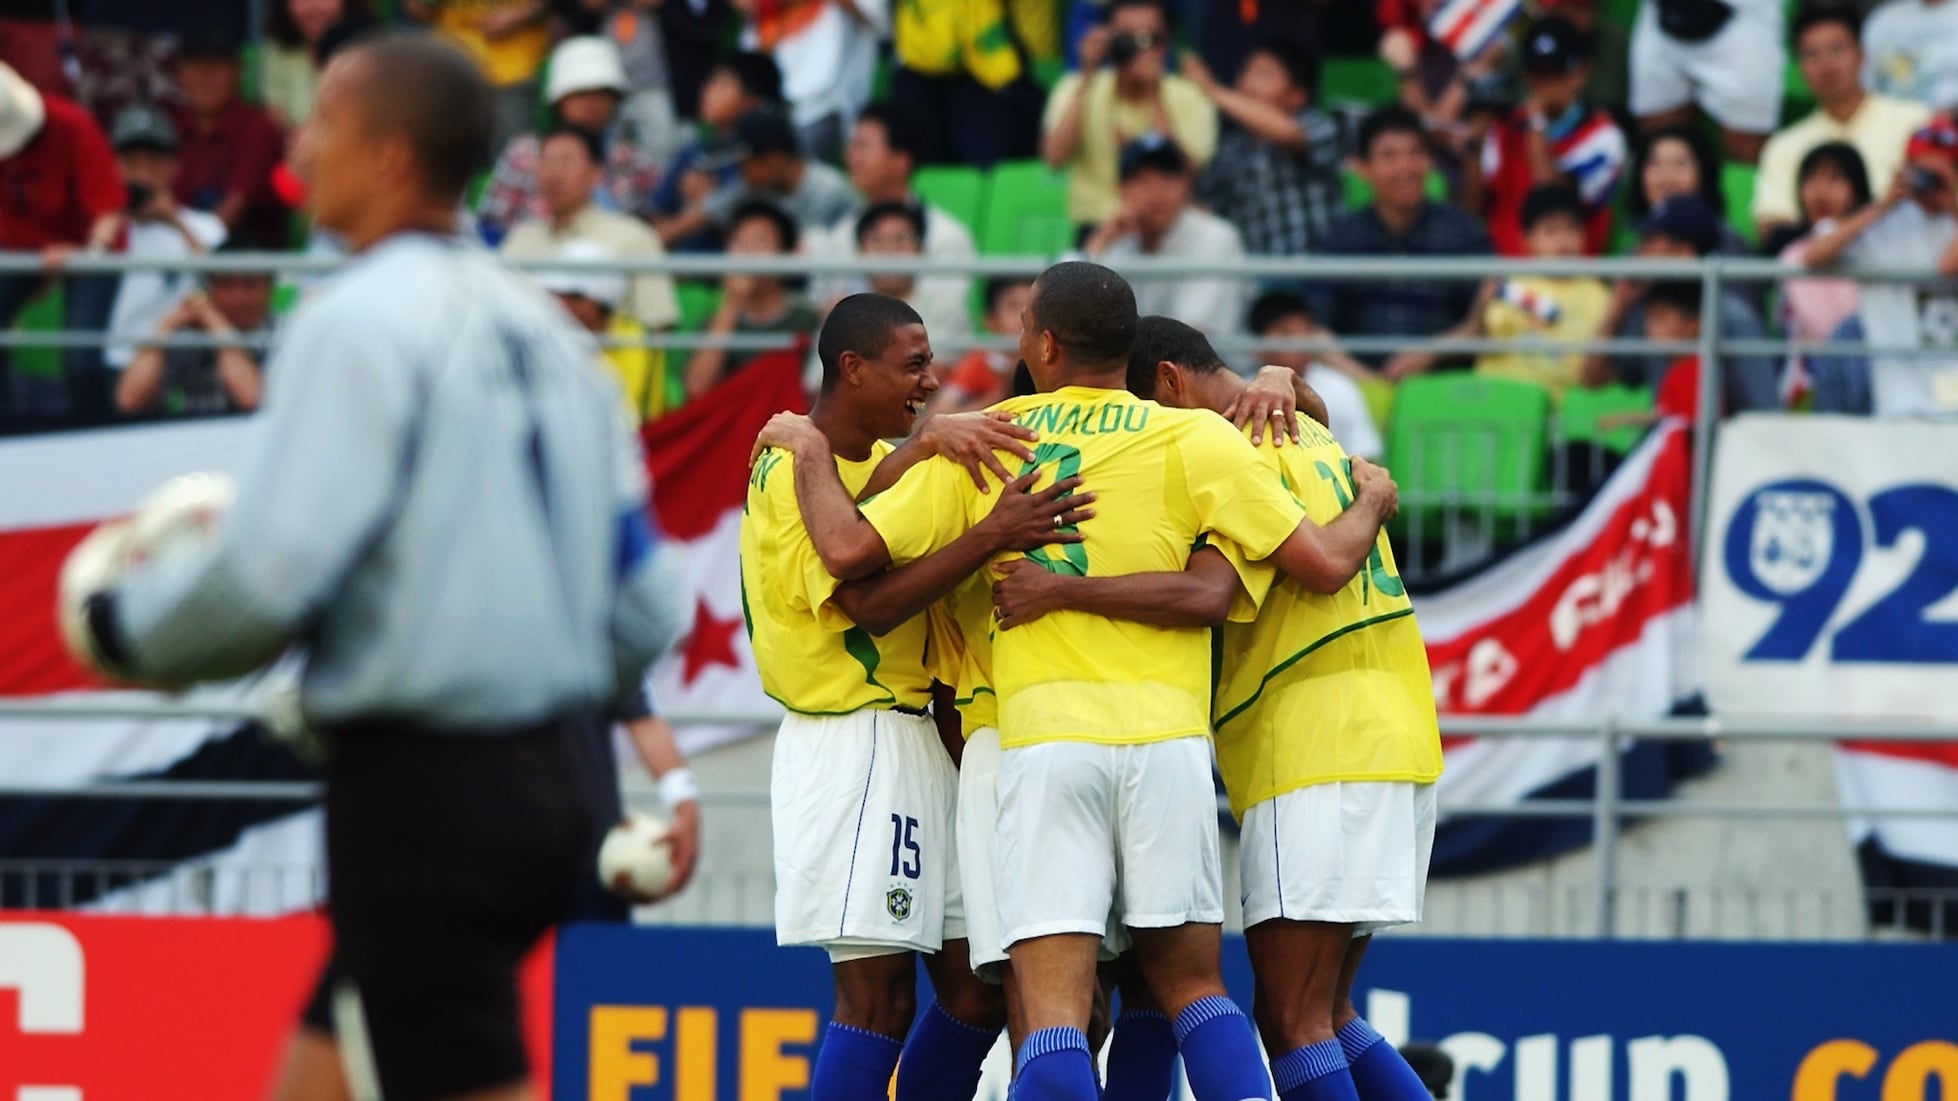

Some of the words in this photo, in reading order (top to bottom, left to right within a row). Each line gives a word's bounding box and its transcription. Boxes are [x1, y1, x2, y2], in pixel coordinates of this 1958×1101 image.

[1724, 478, 1958, 663] 92
[890, 812, 921, 879] 15
[588, 1005, 900, 1101] FIF
